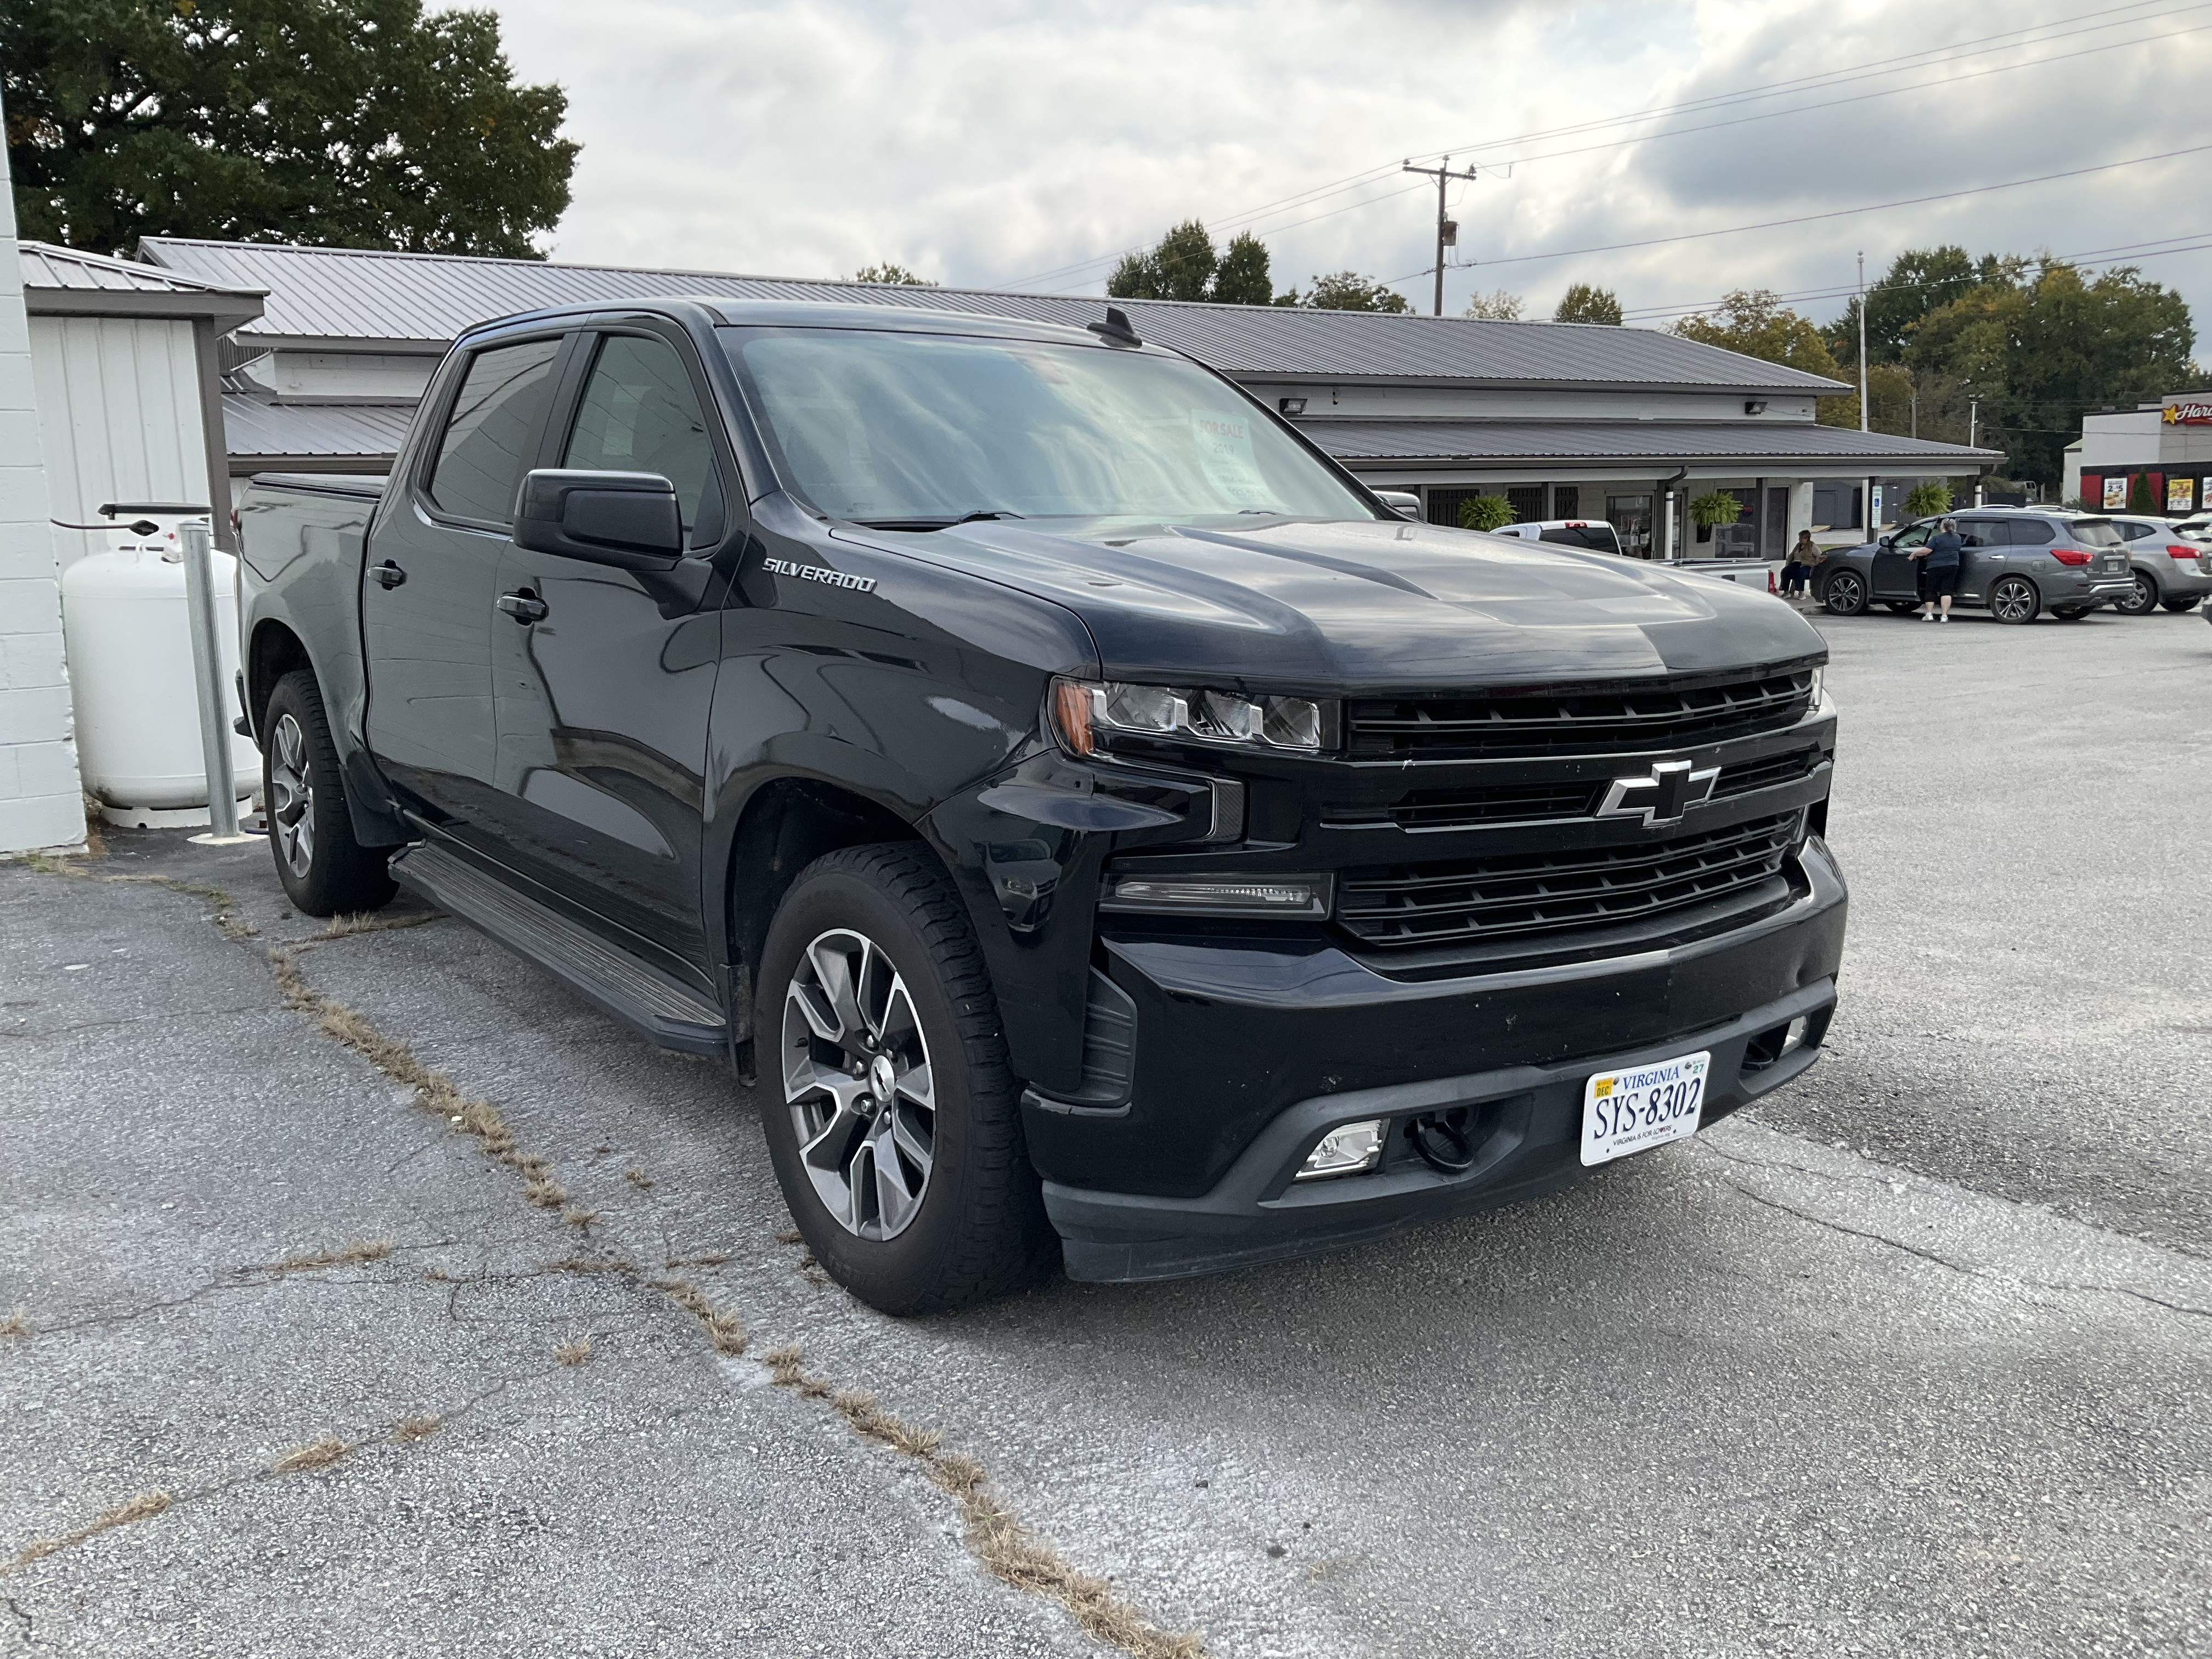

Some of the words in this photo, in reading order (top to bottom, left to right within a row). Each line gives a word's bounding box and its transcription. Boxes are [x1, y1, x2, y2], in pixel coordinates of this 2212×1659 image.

[1200, 420, 1219, 435] FOR
[1221, 423, 1244, 439] SALE
[1214, 443, 1234, 454] 2019
[762, 558, 877, 592] SILVERADO
[1623, 1065, 1679, 1090] VIRGINIA
[1693, 1064, 1704, 1074] 27
[1597, 1086, 1609, 1096] DEC
[1594, 1077, 1701, 1139] SYS-8302
[1613, 1136, 1636, 1146] VIRGINIA
[1642, 1130, 1652, 1138] FOR
